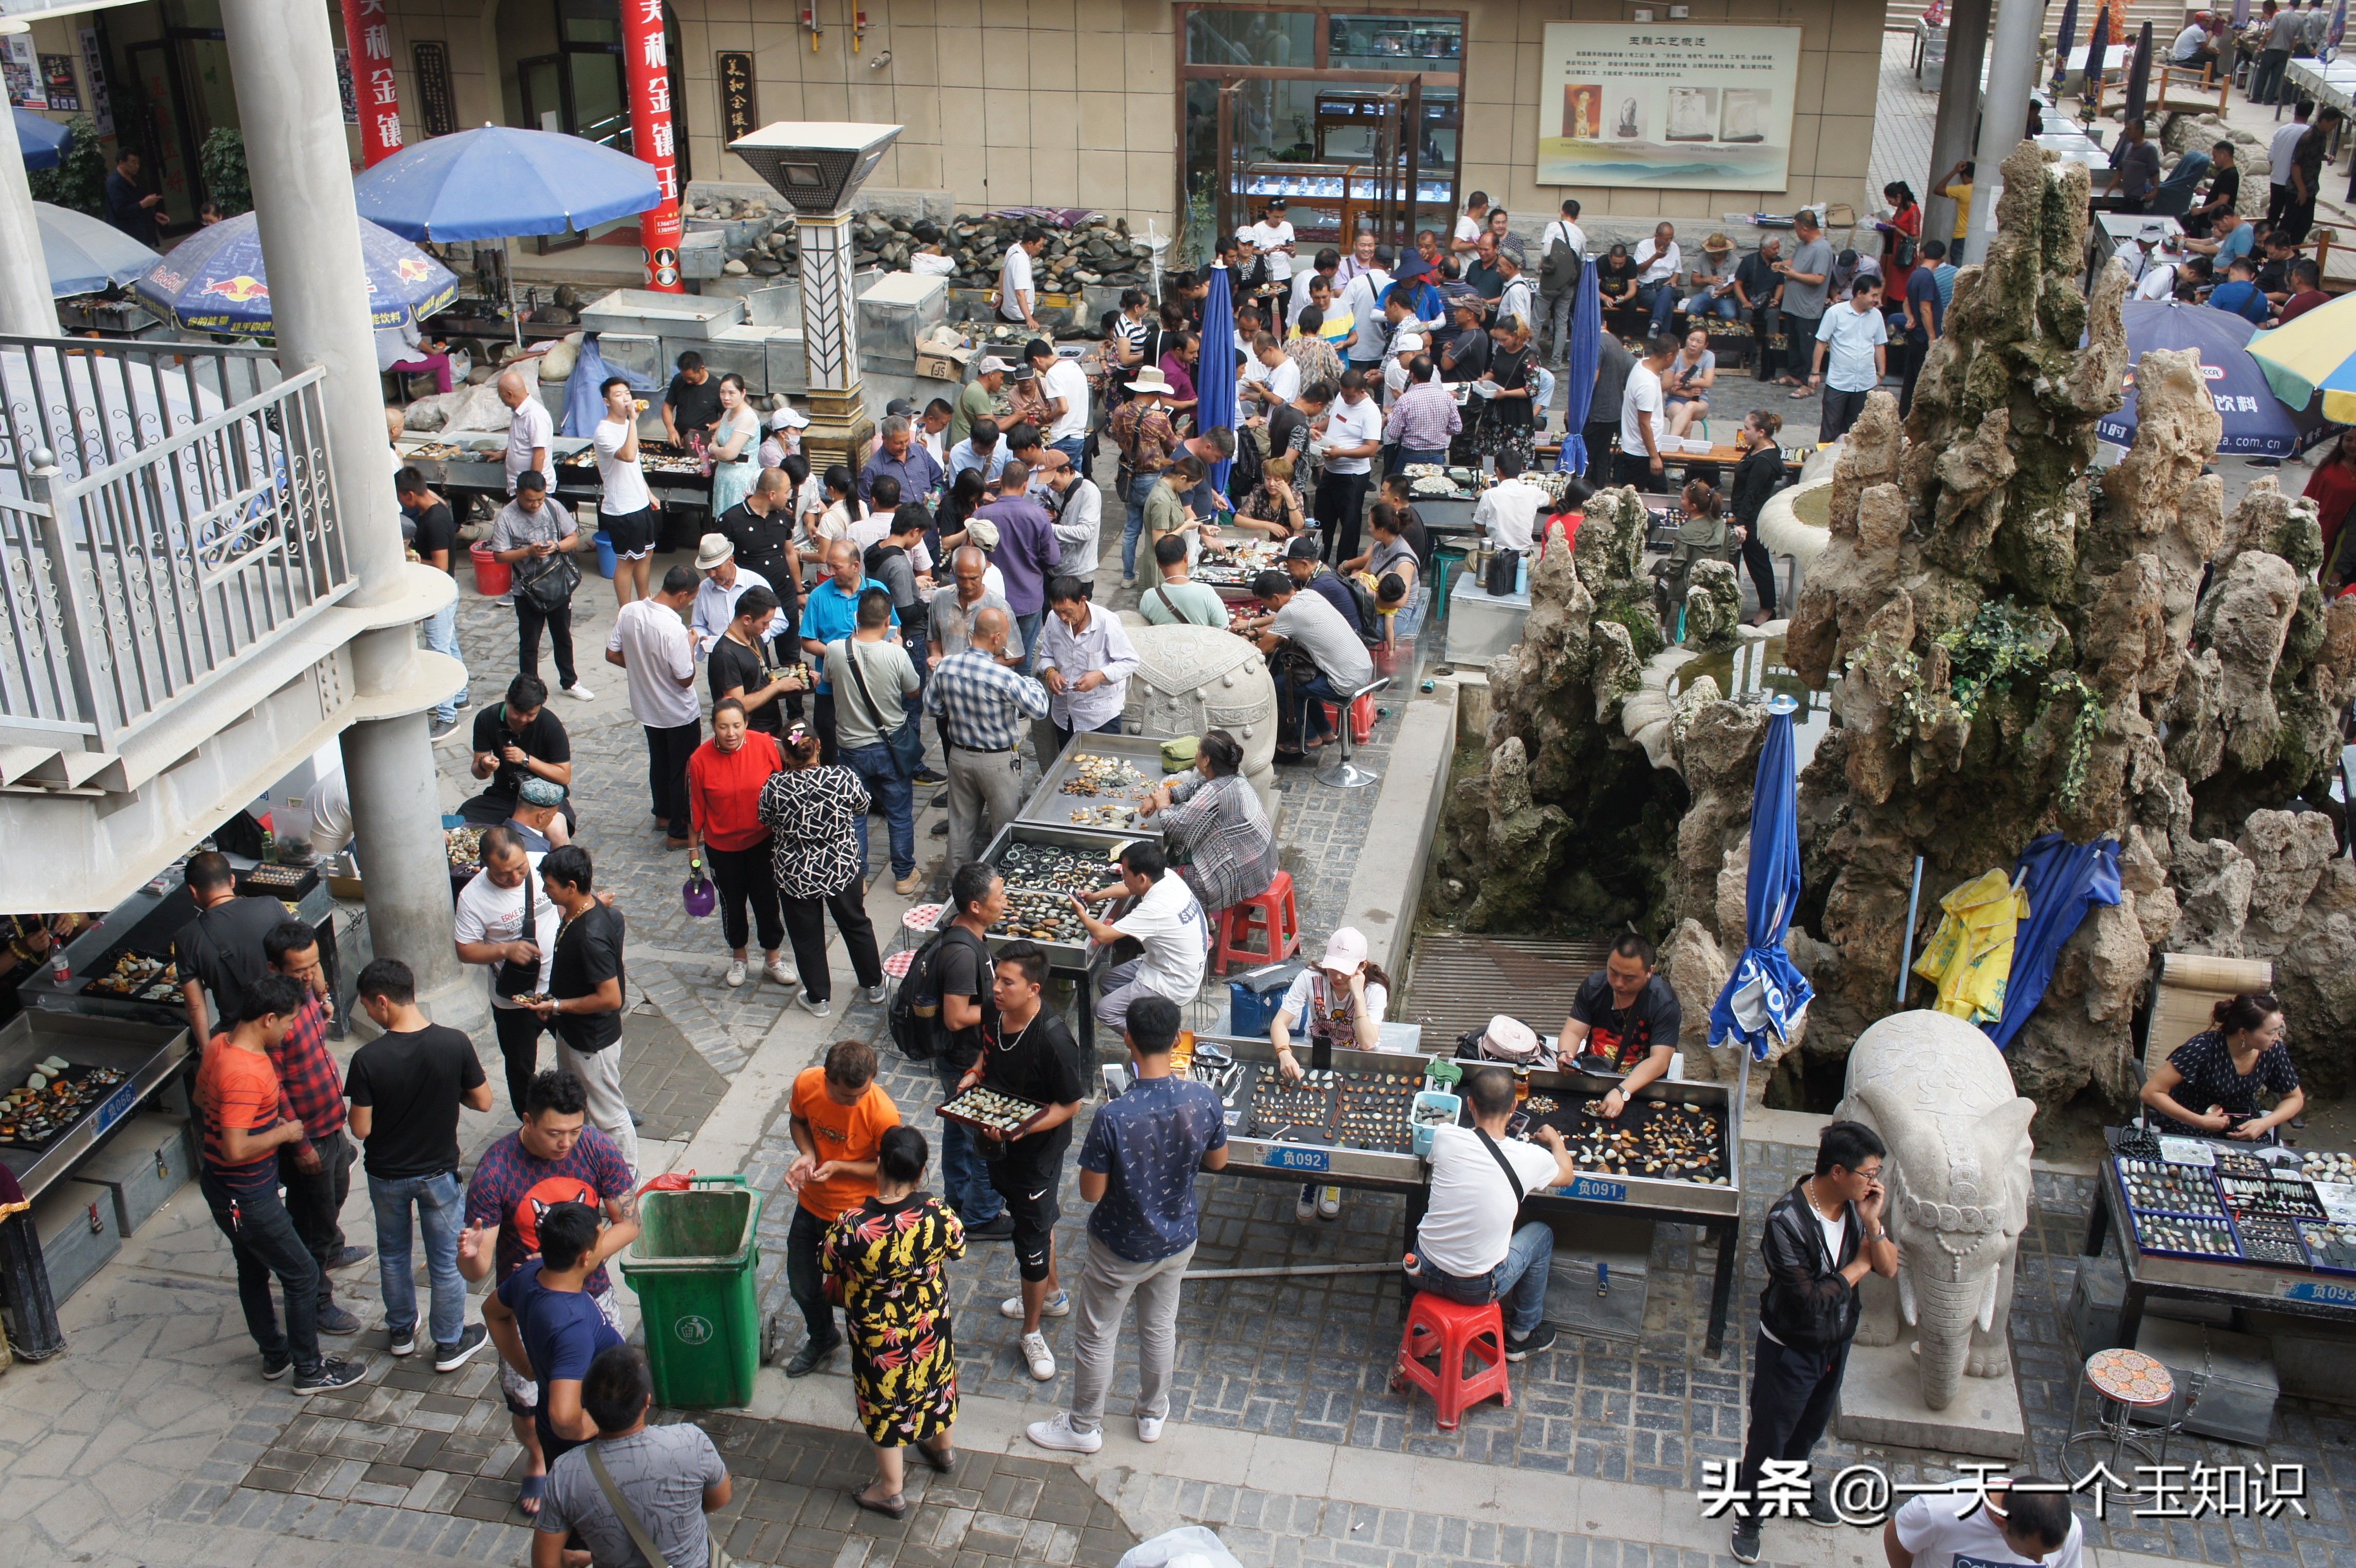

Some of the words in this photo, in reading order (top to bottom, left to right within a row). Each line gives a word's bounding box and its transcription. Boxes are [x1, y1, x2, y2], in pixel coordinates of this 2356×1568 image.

[1629, 36, 1706, 47] 玉雕工艺概述
[150, 265, 188, 294] RedBull
[188, 316, 229, 326] 你的能量
[230, 321, 275, 332] 超乎你想
[2213, 395, 2258, 413] 饮料
[501, 909, 519, 923] ERKE
[108, 1090, 131, 1120] 负066
[1283, 1150, 1321, 1167] 负092
[1578, 1180, 1617, 1197] 负091
[2311, 1284, 2356, 1302] 负093
